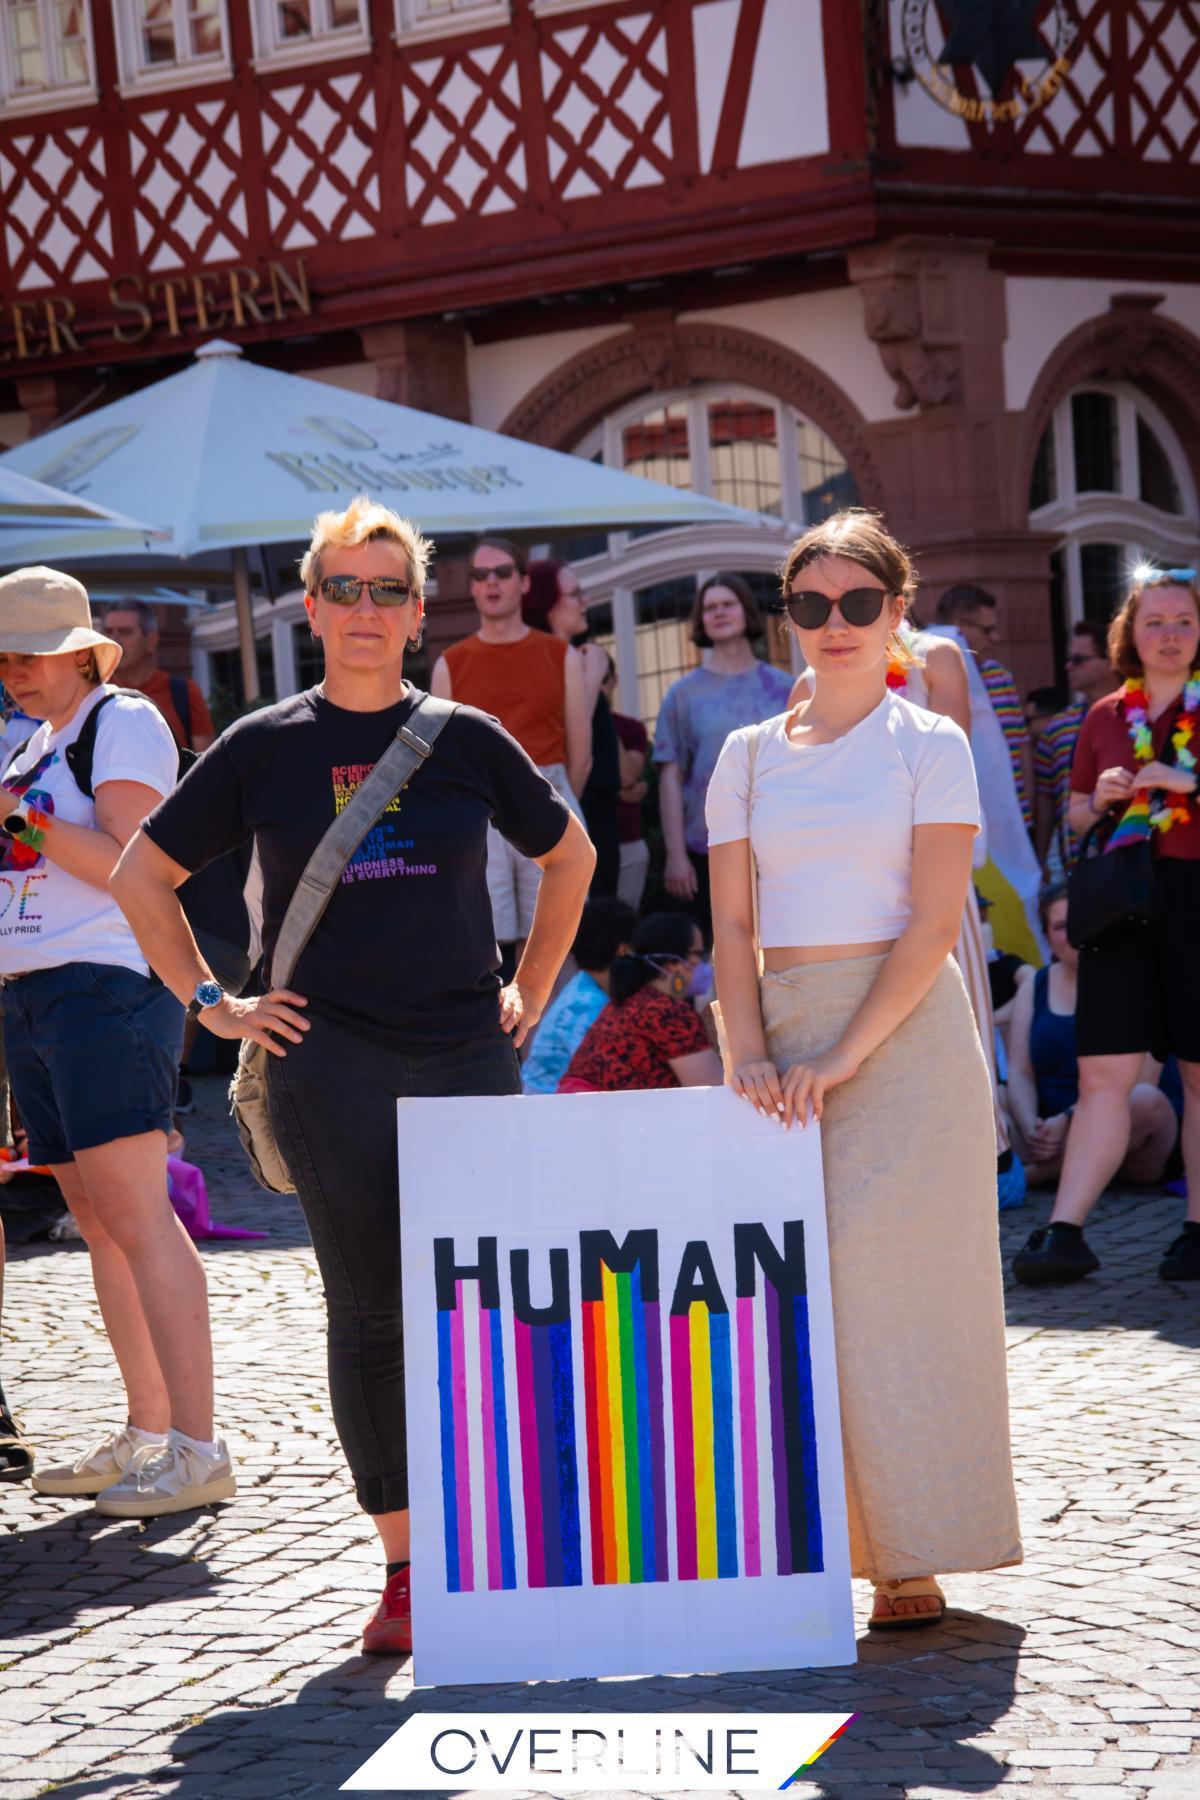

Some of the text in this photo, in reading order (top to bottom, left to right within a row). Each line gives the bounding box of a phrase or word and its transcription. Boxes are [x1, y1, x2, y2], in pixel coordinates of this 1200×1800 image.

[0, 256, 311, 361] ER STERN
[331, 763, 376, 776] SCIENC
[333, 780, 363, 793] BLAC
[342, 864, 438, 885] IS EVERYTHING
[14, 925, 42, 934] PRIDE
[433, 1219, 809, 1326] HUMAN
